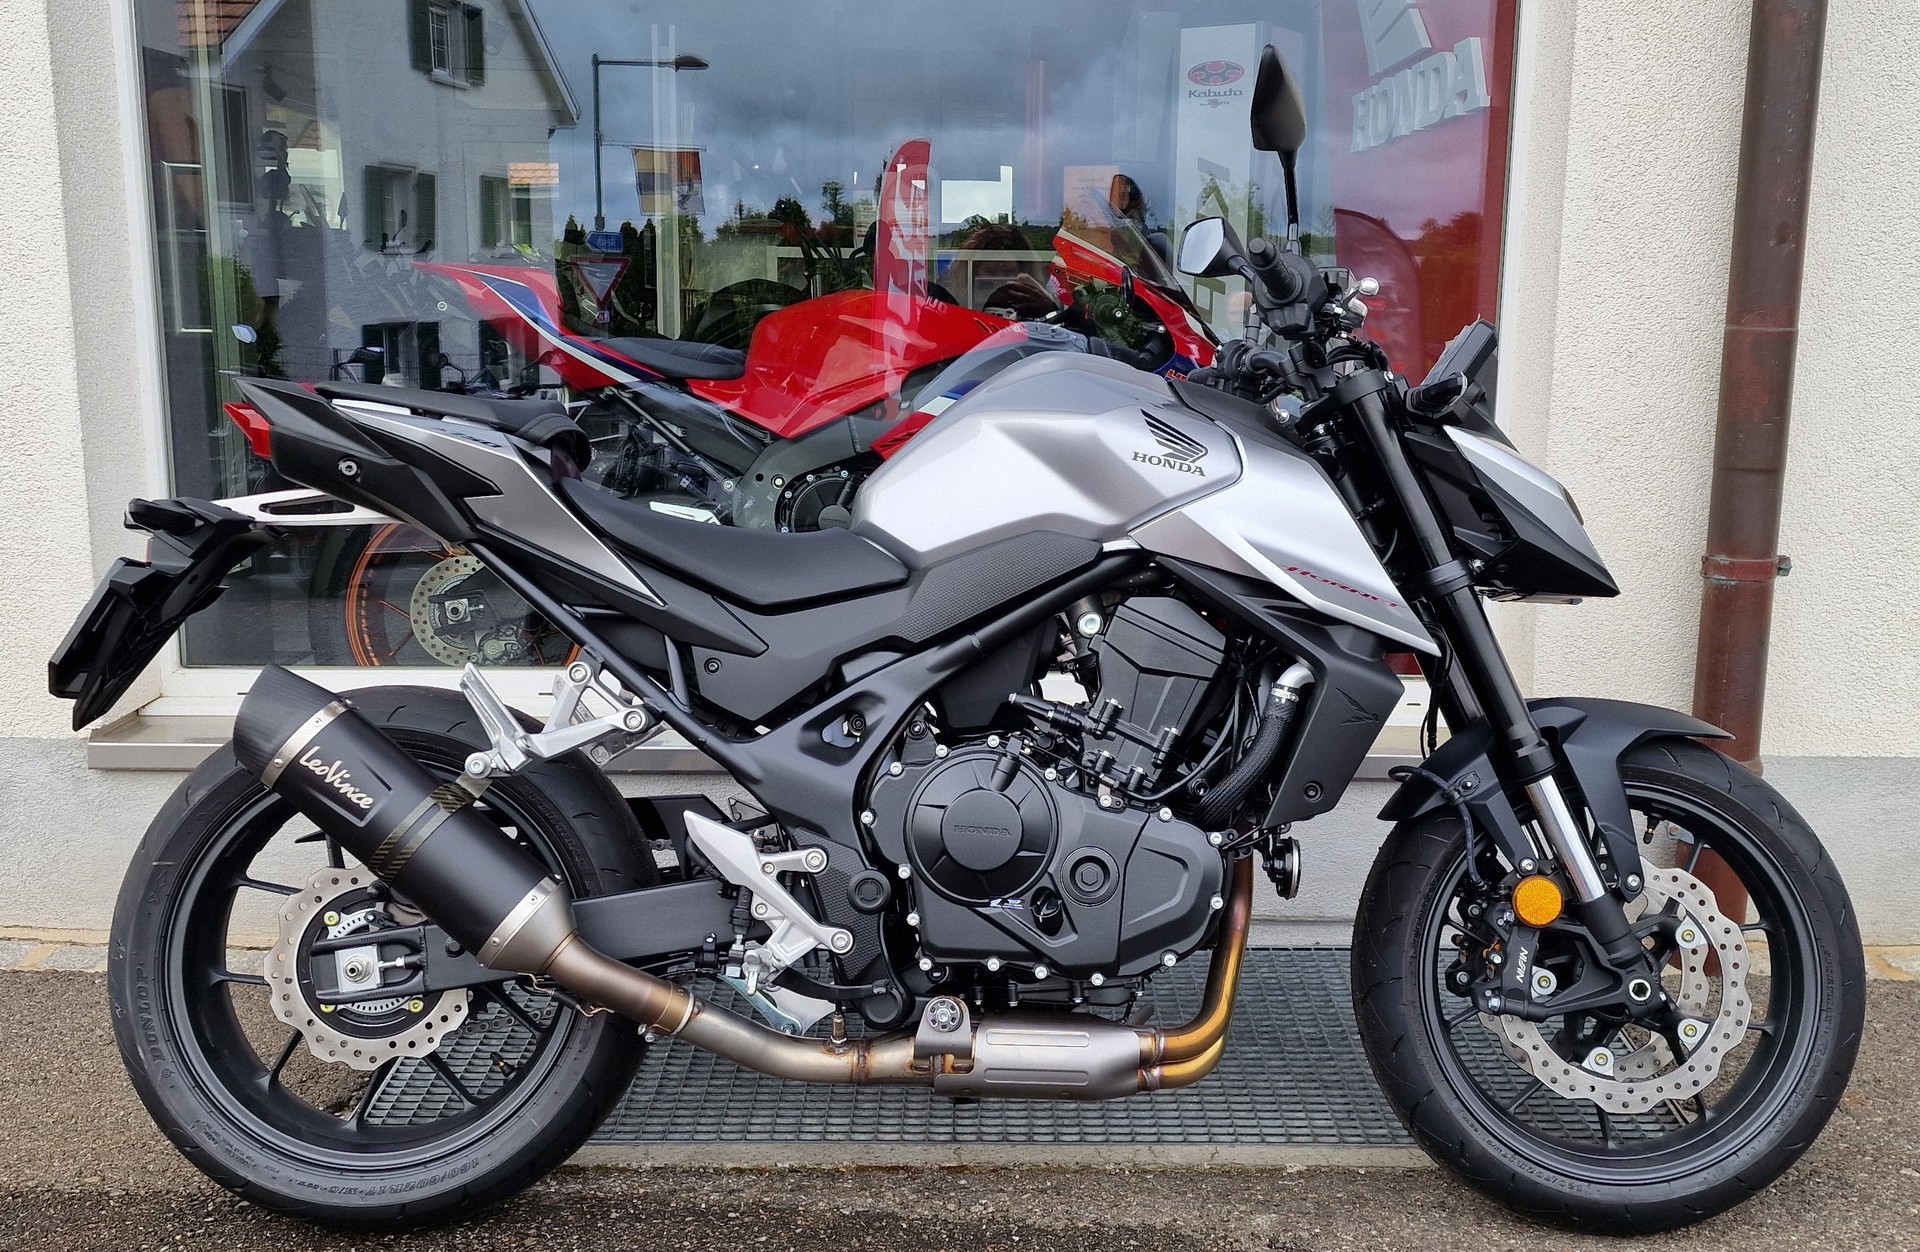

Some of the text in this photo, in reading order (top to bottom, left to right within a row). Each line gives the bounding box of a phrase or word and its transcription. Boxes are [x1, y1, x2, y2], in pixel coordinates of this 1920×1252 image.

[1189, 88, 1243, 98] Kabuto
[1350, 37, 1491, 153] HONDA
[1131, 451, 1206, 477] HONDA
[299, 746, 374, 809] LeoVince
[953, 825, 1012, 836] HONDA
[135, 966, 166, 1063] DUNLOP
